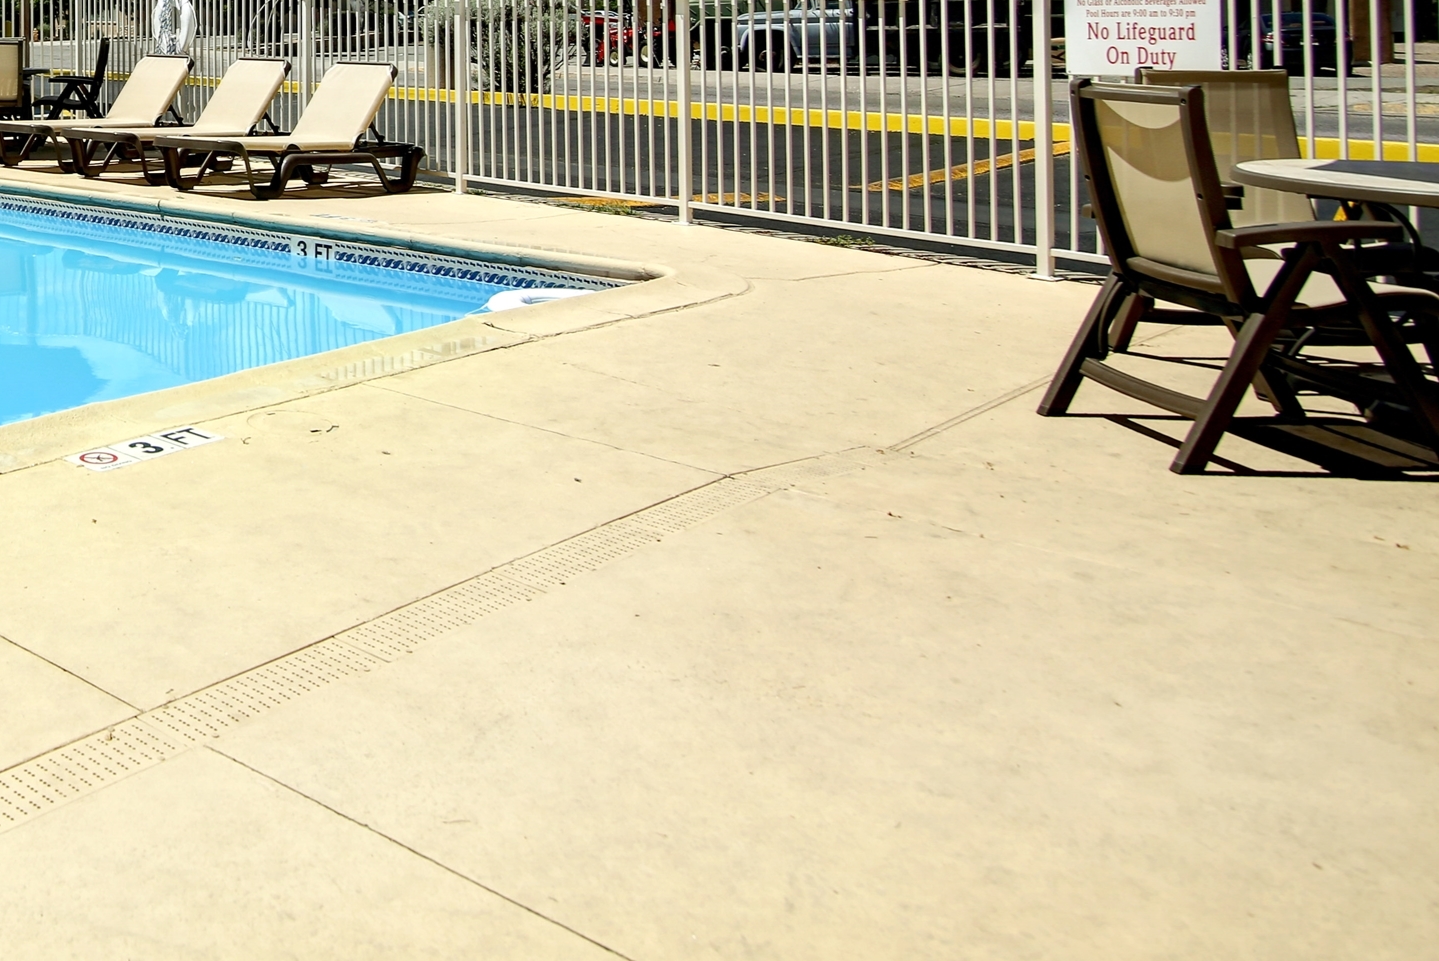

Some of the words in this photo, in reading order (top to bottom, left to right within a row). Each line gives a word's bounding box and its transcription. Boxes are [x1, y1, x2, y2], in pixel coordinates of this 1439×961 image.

[1086, 9, 1100, 18] Pool
[1101, 9, 1119, 18] Hours
[1133, 8, 1147, 17] 9:00
[1160, 9, 1167, 17] to
[1168, 8, 1184, 17] 9:30
[1185, 10, 1196, 19] pm
[1087, 22, 1109, 40] No
[1116, 22, 1196, 45] Lifeguard
[1106, 46, 1130, 64] On
[1137, 46, 1177, 70] Duty
[297, 240, 307, 256] 3
[315, 243, 332, 260] FT
[128, 441, 164, 454] 3
[160, 427, 211, 445] FT
